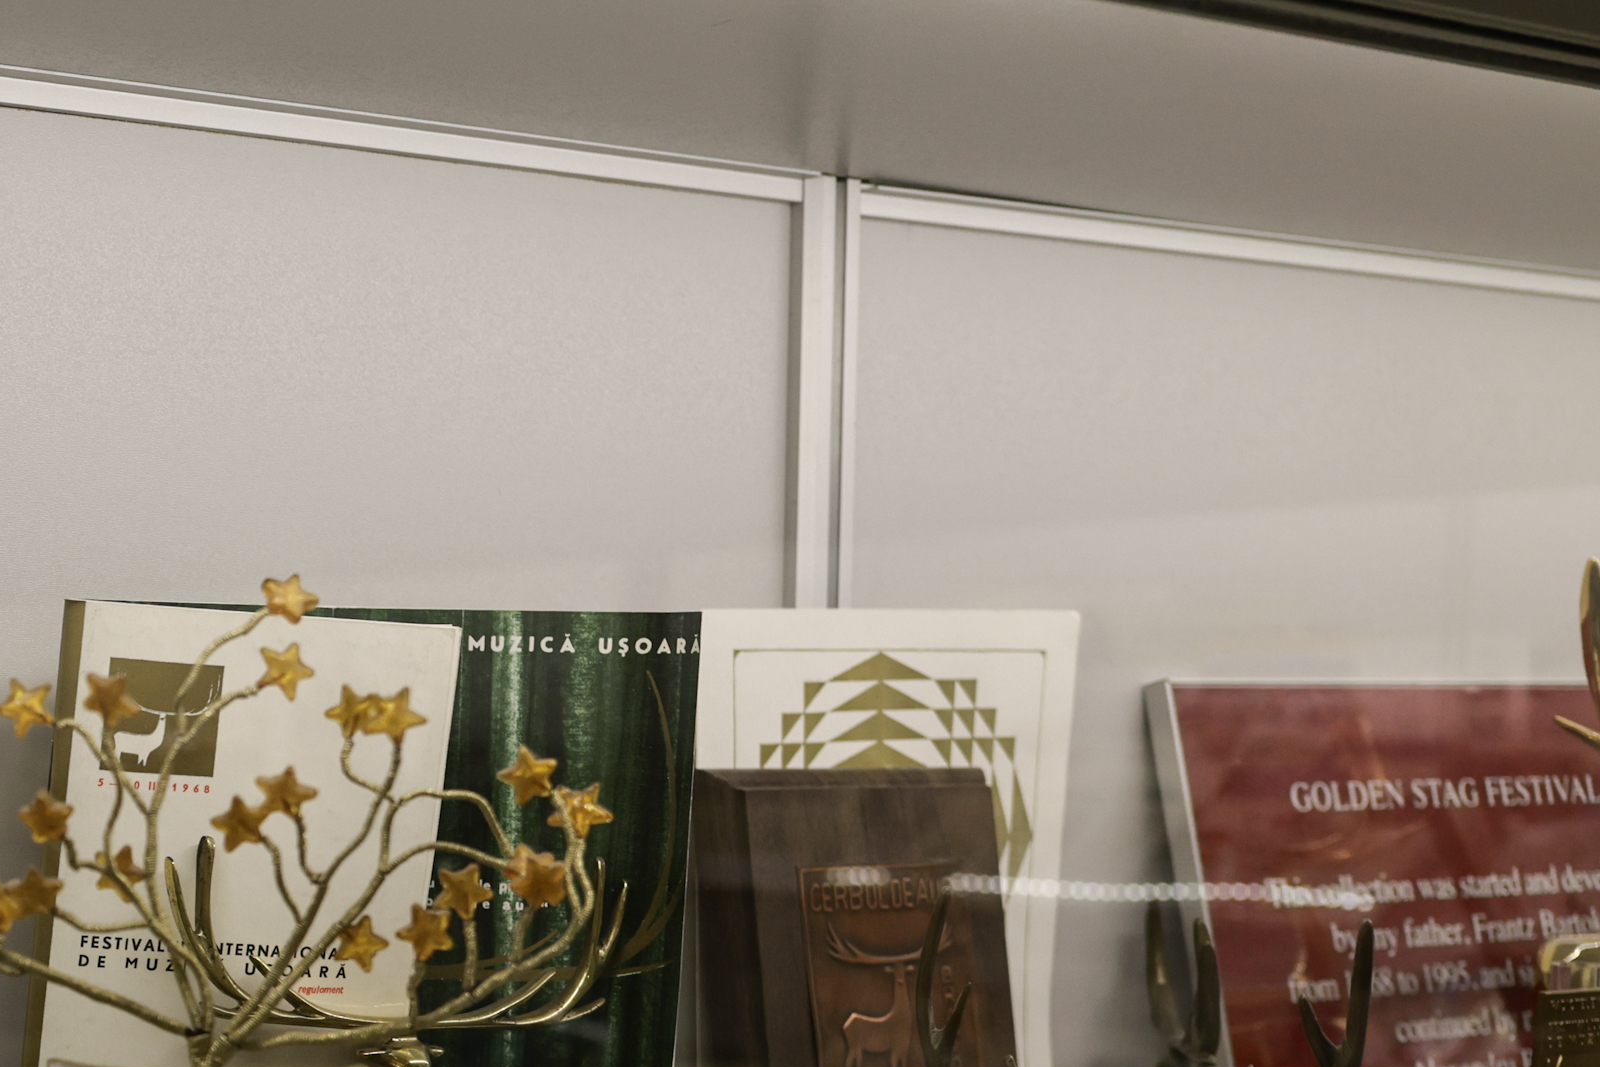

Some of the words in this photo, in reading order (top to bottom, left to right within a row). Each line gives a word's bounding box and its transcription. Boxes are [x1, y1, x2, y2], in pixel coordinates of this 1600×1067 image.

[467, 633, 576, 654] MUZICĂ
[598, 634, 700, 657] UȘOARĂ
[1289, 779, 1404, 812] GOLDEN
[1410, 776, 1479, 809] STAG
[78, 954, 106, 969] DE
